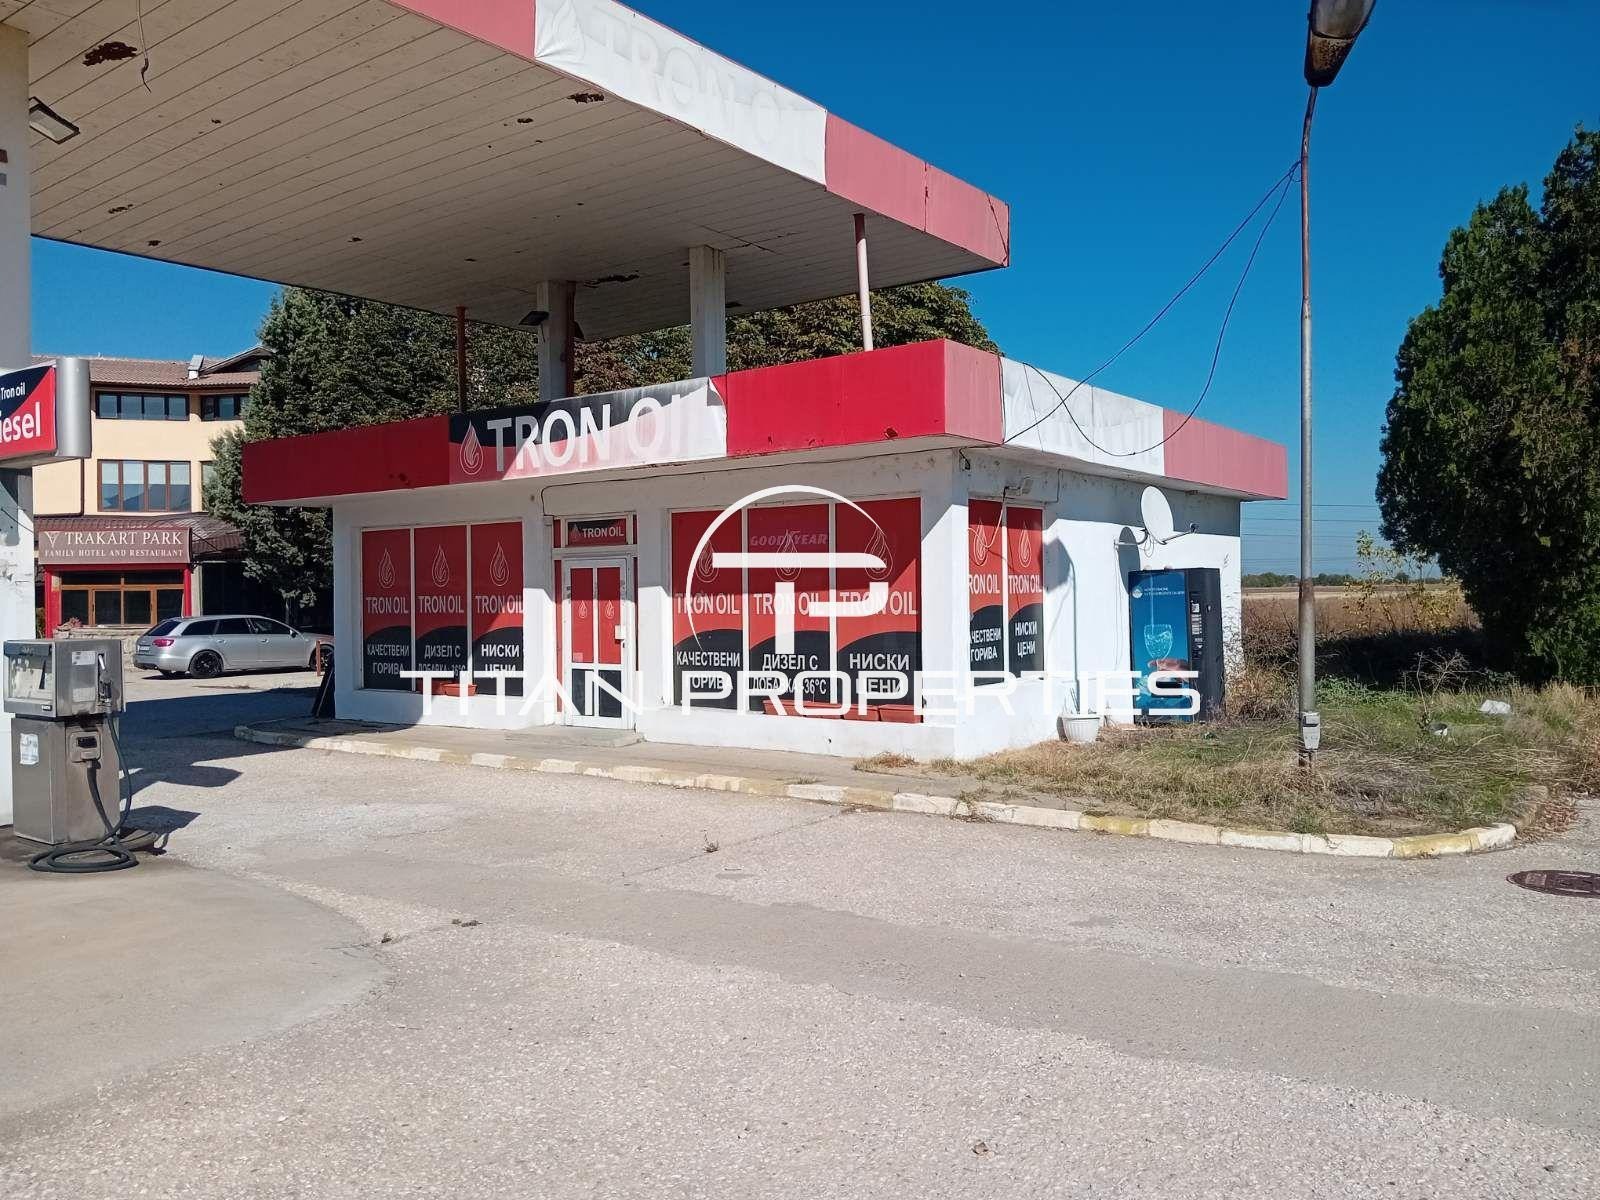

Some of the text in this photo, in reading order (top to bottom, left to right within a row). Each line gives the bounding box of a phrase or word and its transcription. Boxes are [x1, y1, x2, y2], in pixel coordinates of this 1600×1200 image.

[1, 382, 26, 400] Tron oil
[486, 402, 612, 472] TRON
[64, 531, 183, 546] TRAKART PARK
[582, 526, 624, 539] TRON OIL
[45, 549, 183, 557] FAMILY HOTEL AND RESTAURANT
[968, 573, 1000, 594] RON OIL
[1008, 574, 1042, 594] TRON OIL
[366, 596, 409, 614] TRON OIL
[417, 595, 465, 614] TRON OIL
[475, 595, 524, 614] TRON OIL
[675, 592, 741, 614] TRON OIL
[889, 590, 917, 615] OIL
[970, 627, 1001, 644] ЧЕСТВЕНИ
[1014, 620, 1038, 636] НИСКИ
[367, 644, 410, 657] КАЧЕСТВЕНИ
[424, 645, 453, 659] ДИЗЕЛ
[481, 644, 520, 658] НИСКИ
[970, 645, 998, 662] ГОРИВА
[1017, 640, 1036, 658] ЦЕНИ
[676, 651, 740, 667] КАЧЕСТВЕНИ
[762, 653, 806, 672] ДИЗЕЛ
[849, 653, 910, 671] НИСКИ
[372, 662, 404, 675] ГОРИВА
[685, 675, 734, 690] ОРИВ
